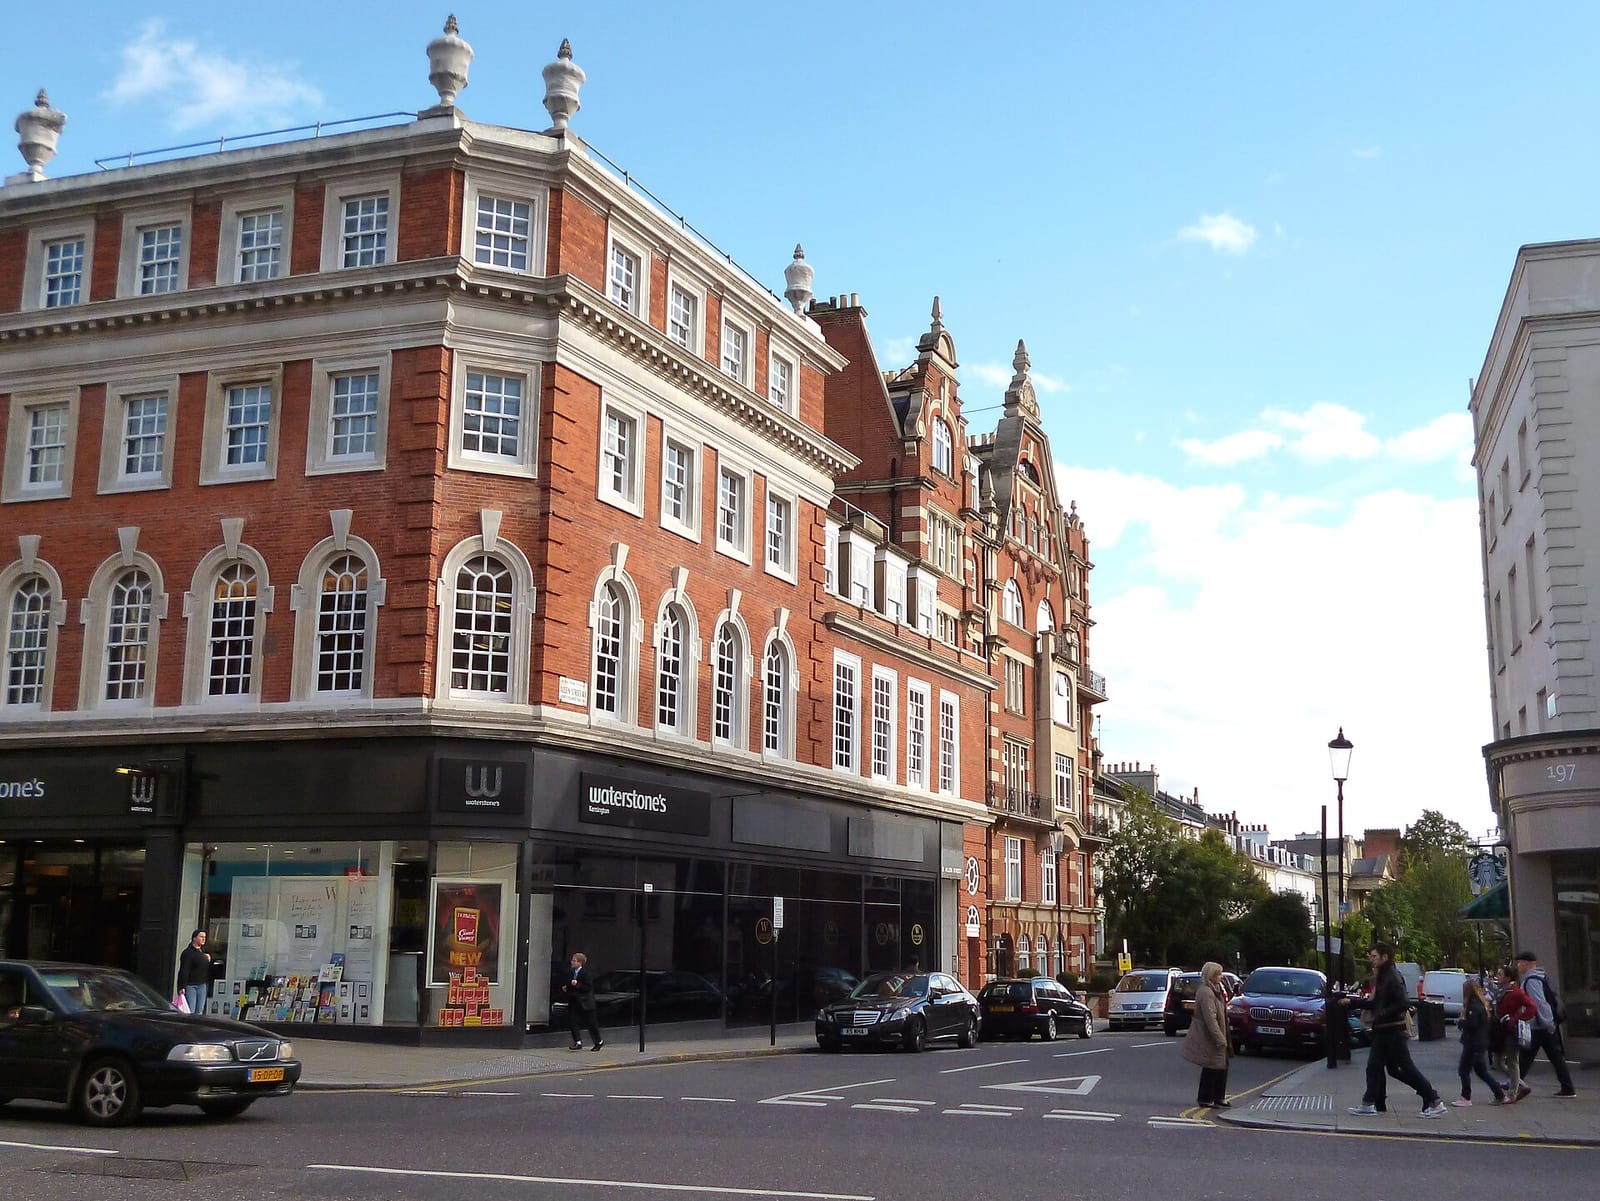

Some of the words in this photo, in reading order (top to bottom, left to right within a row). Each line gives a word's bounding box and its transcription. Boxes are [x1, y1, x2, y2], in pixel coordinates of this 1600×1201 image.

[1547, 764, 1576, 782] 197
[589, 786, 667, 812] waterstone's
[449, 951, 482, 966] NEW
